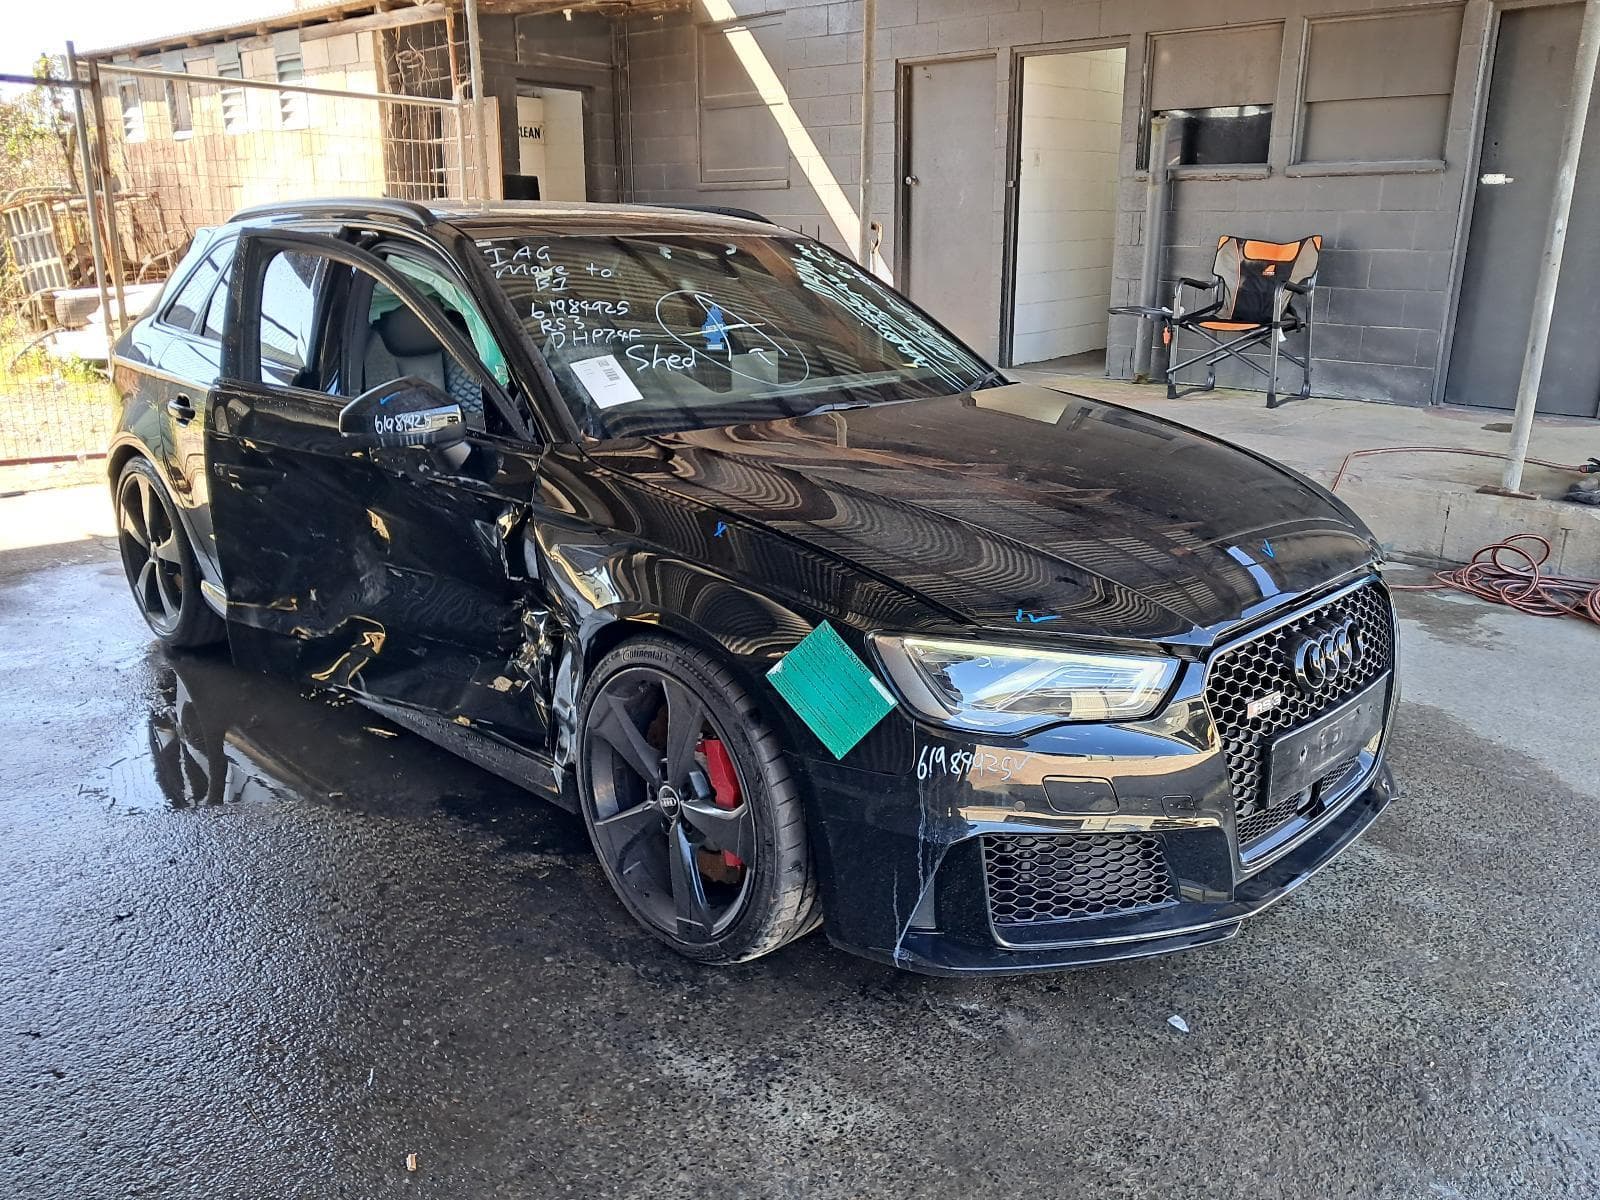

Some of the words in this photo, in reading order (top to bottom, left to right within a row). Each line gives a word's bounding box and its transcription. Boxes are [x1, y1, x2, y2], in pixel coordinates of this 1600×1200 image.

[520, 126, 541, 139] LEAN
[484, 245, 551, 268] IAG
[585, 262, 612, 278] to
[625, 344, 697, 372] Shed
